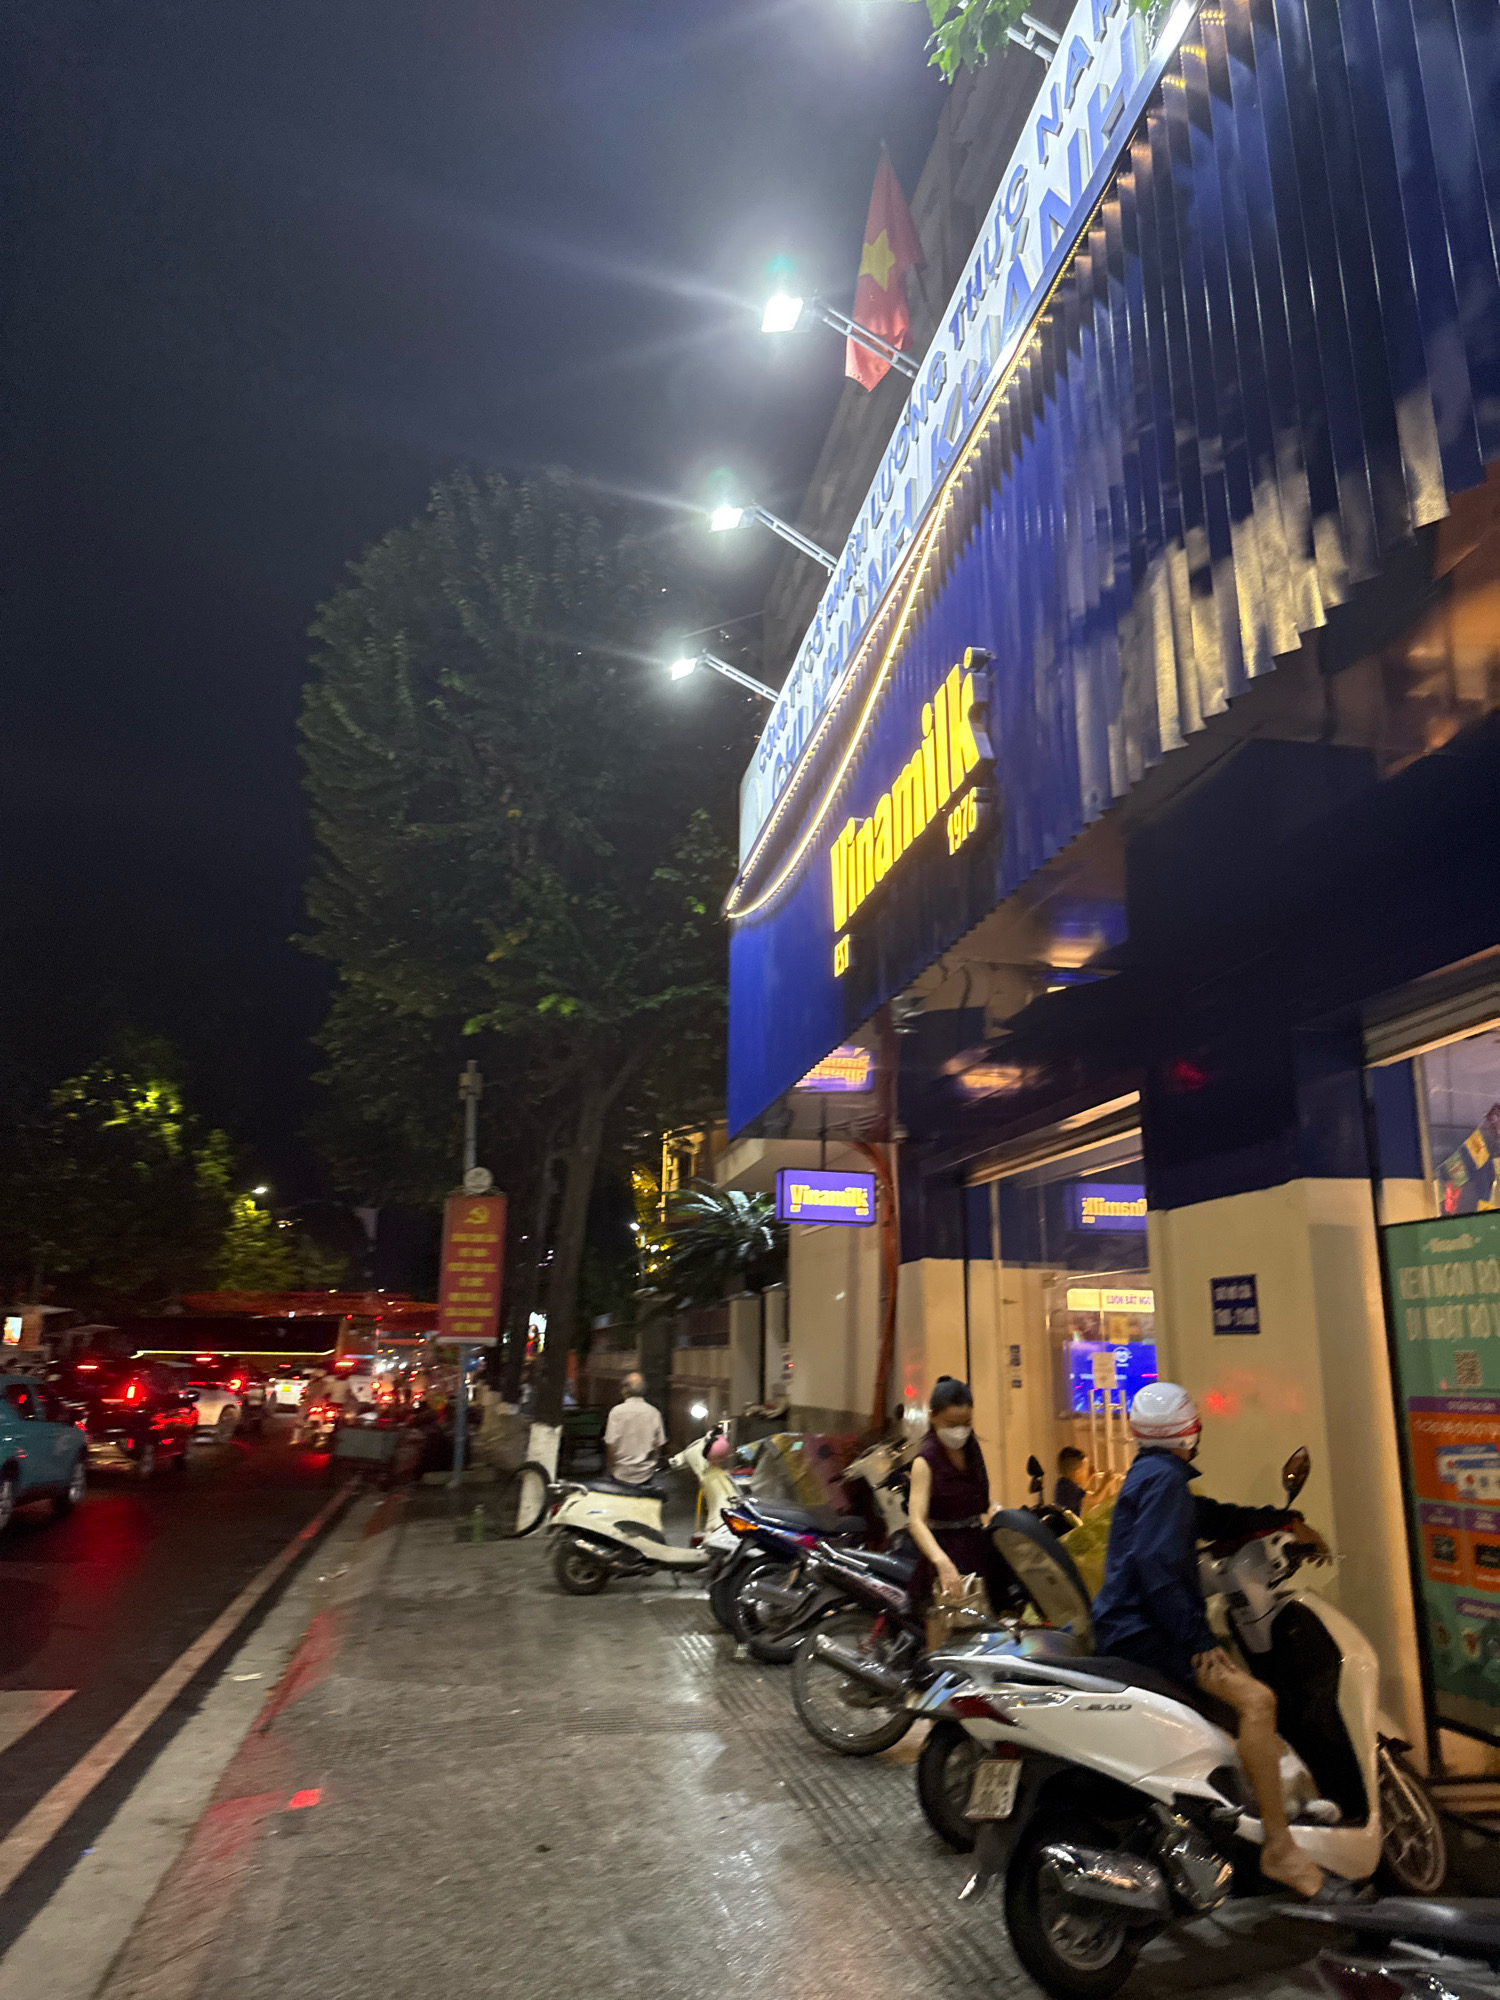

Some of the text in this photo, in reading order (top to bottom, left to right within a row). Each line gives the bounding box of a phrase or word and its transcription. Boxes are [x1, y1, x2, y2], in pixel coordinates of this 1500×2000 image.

[870, 351, 948, 531] LƯƠNG
[948, 163, 1029, 351] THỰC
[830, 655, 980, 933] Vinamilk
[947, 786, 977, 856] 1976
[789, 1184, 870, 1208] Vinamilk
